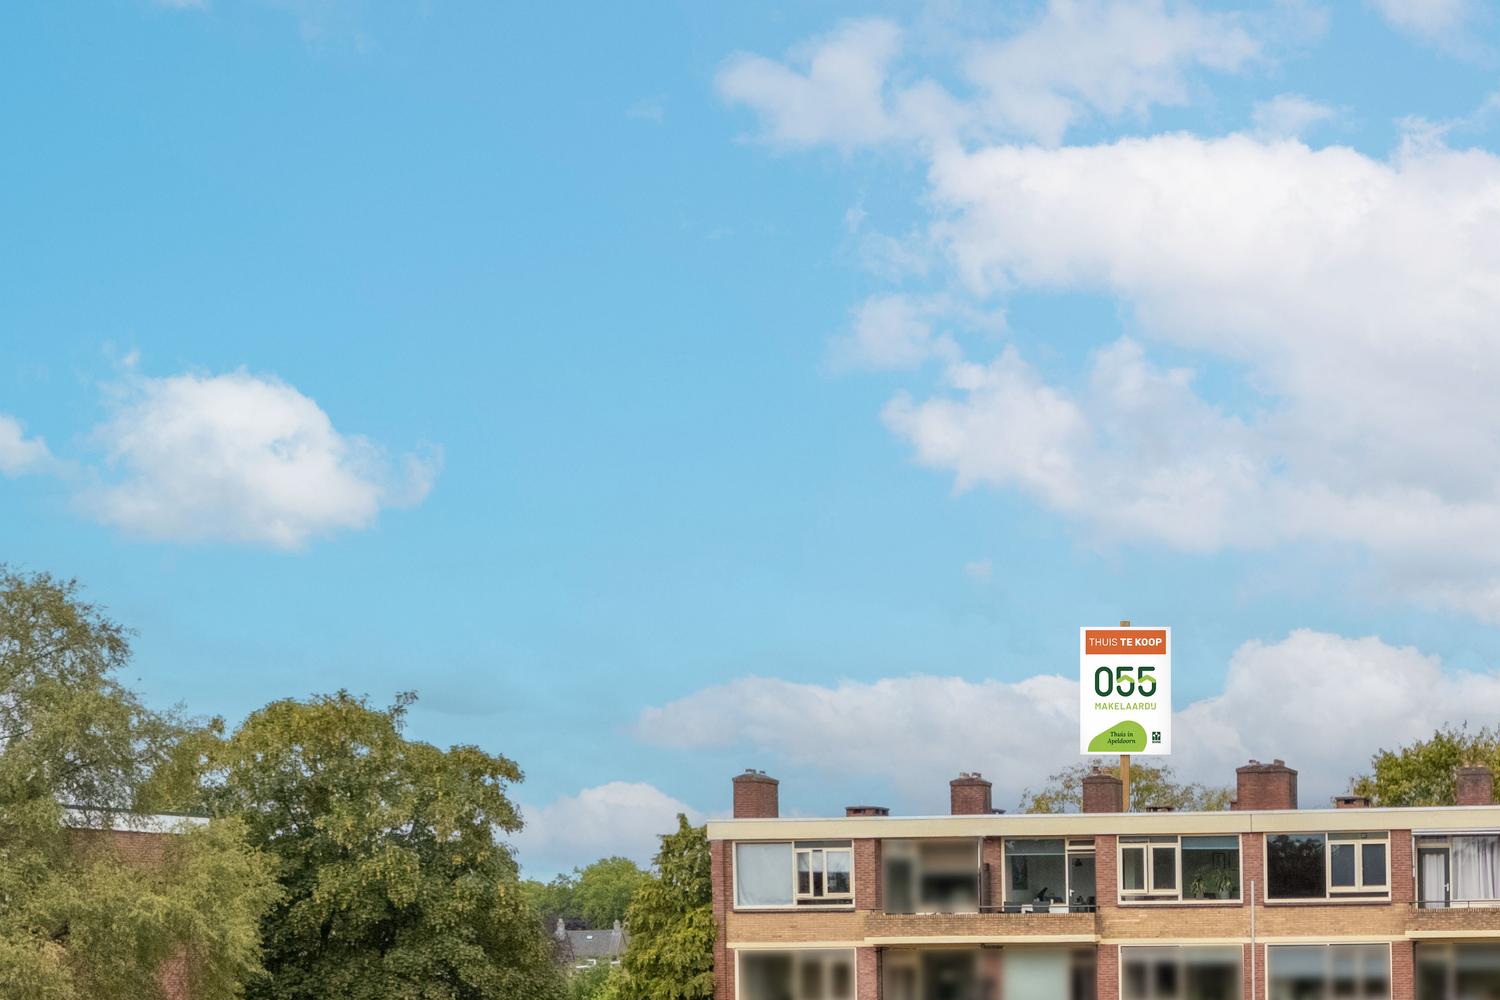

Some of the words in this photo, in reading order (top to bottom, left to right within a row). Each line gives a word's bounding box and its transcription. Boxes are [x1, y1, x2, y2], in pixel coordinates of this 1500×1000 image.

[1089, 638, 1118, 646] THUIS
[1120, 638, 1133, 646] TE
[1135, 638, 1162, 646] KOOP
[1095, 666, 1157, 697] 055
